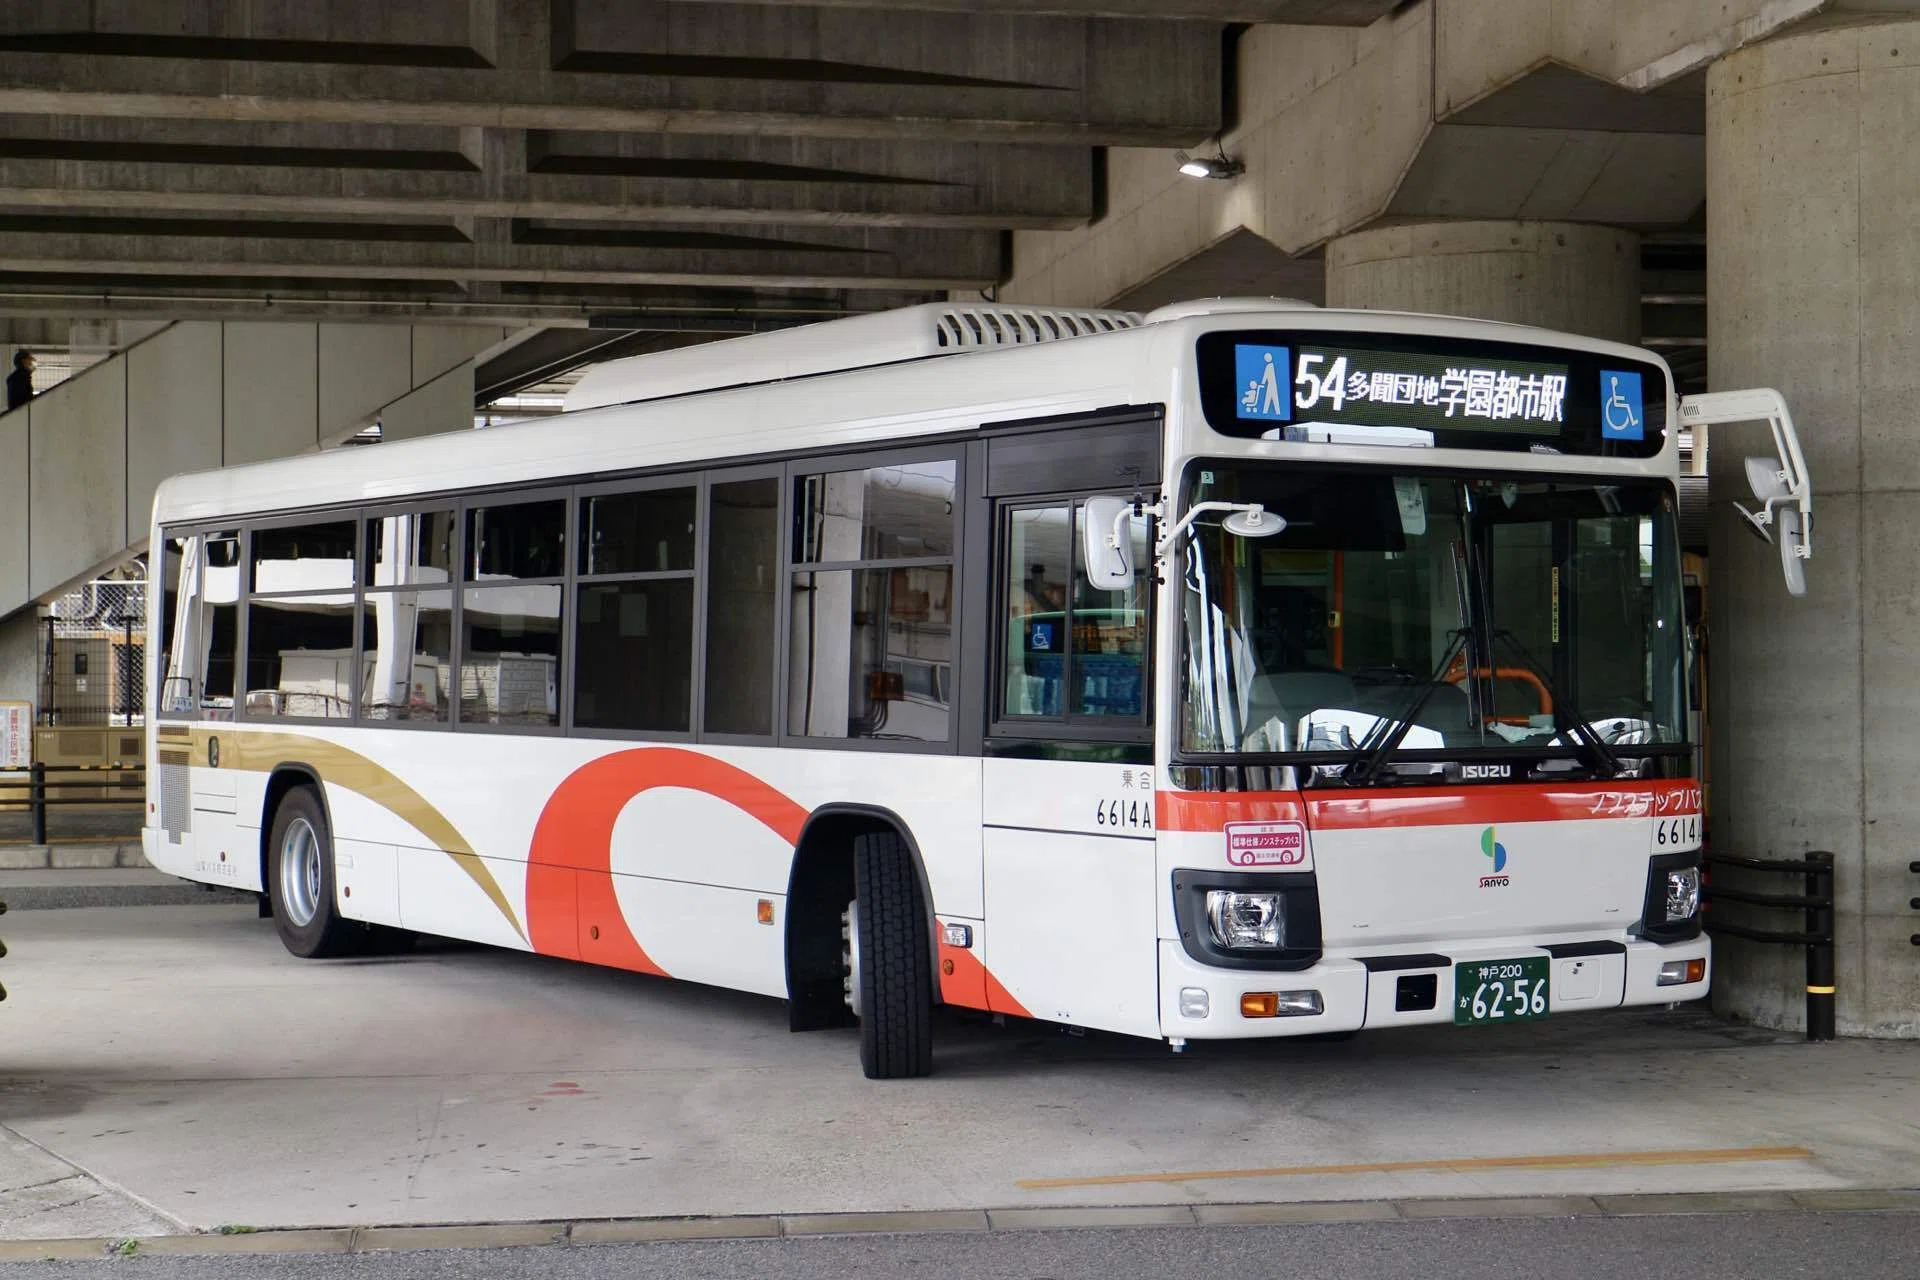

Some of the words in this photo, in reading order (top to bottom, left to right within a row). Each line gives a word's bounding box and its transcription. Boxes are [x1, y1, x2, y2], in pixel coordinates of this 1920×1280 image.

[1295, 353, 1348, 411] 54
[1346, 371, 1439, 406] 多聞団地
[1439, 367, 1567, 422] 学園都市駅
[1121, 769, 1151, 790] 乗合
[1462, 765, 1511, 779] ISUZU
[1097, 798, 1152, 829] 6614A
[1479, 875, 1510, 888] SANYO
[1472, 978, 1546, 1020] 62-56
